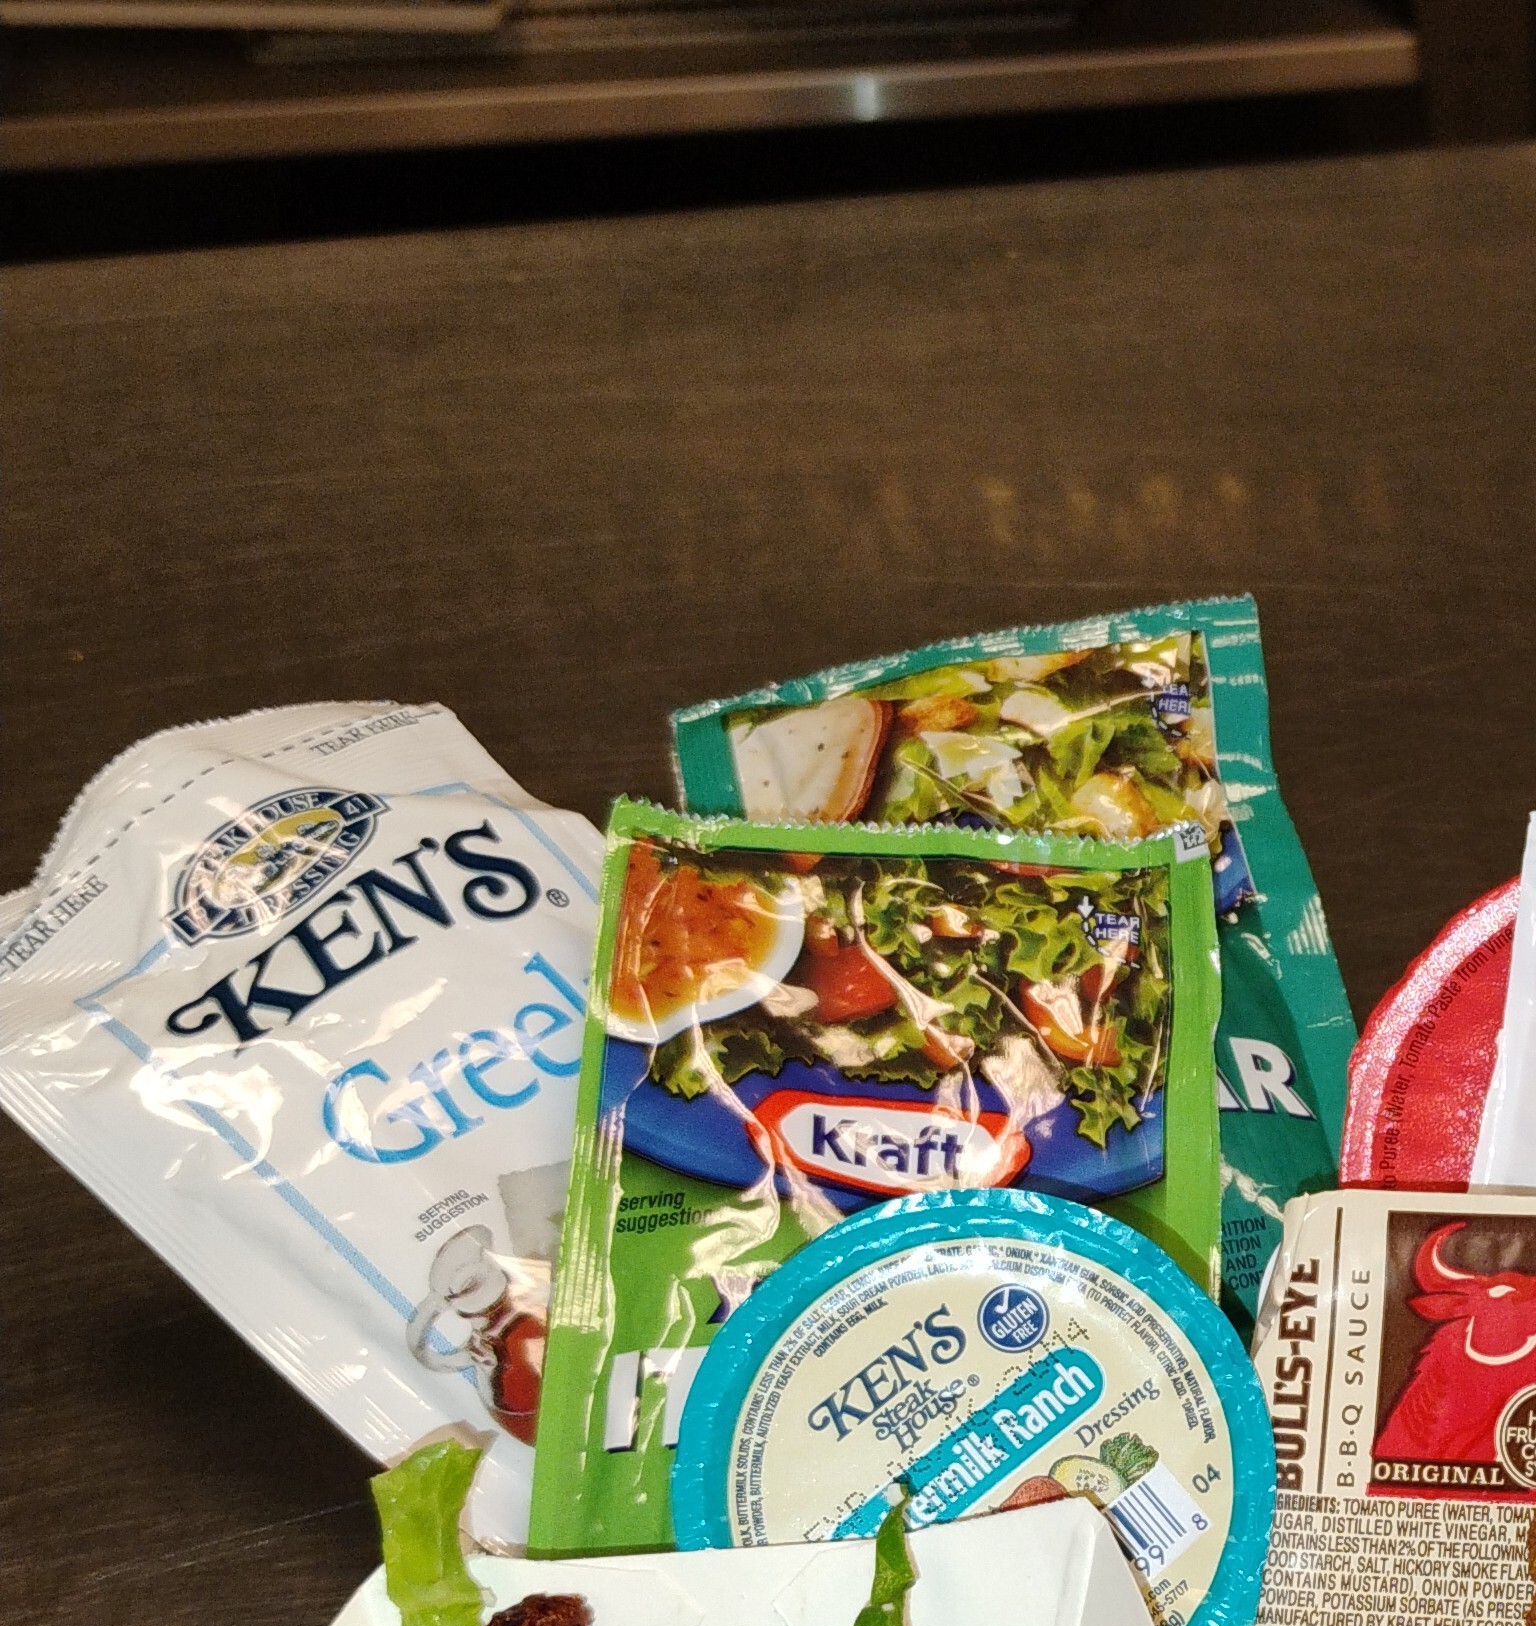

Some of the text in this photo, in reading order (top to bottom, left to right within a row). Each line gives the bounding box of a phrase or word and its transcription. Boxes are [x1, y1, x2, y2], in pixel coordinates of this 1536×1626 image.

[309, 709, 418, 757] TEAR HERE
[344, 794, 371, 817] 41
[2, 917, 53, 971] TEAR
[53, 875, 110, 929] HERE
[165, 818, 543, 1054] KEN'S
[1094, 926, 1140, 945] HERE
[1095, 912, 1141, 929] TEAR
[1428, 976, 1463, 1014] Paste
[811, 1113, 966, 1180] Kraft
[414, 1192, 490, 1243] SUGGESTION
[418, 1188, 471, 1224] SERVING
[619, 1190, 686, 1213] serving
[1225, 1253, 1257, 1273] AND
[990, 1296, 1040, 1341] GLUTEN
[1012, 1318, 1040, 1346] FREE
[1344, 1268, 1371, 1386] SAUCE
[806, 1302, 968, 1443] KEN'S
[871, 1378, 941, 1442] Steak
[991, 1362, 1097, 1450] Ranch
[1073, 1376, 1163, 1450] Dressing
[1373, 1461, 1505, 1487] ORIGINAL
[1344, 1499, 1494, 1524] TOMATO PUREE (WATER,
[1321, 1517, 1512, 1544] DISTILLED WHITE VINEGAR,
[1327, 1534, 1461, 1559] LESS THAN 2% OF THE
[1300, 1552, 1499, 1580] STARCH, SALT, HICKORY SMOKE
[1340, 1573, 1469, 1597] MUSTARD), ONION
[1322, 1592, 1460, 1617] POTASSIUM SORBATE
